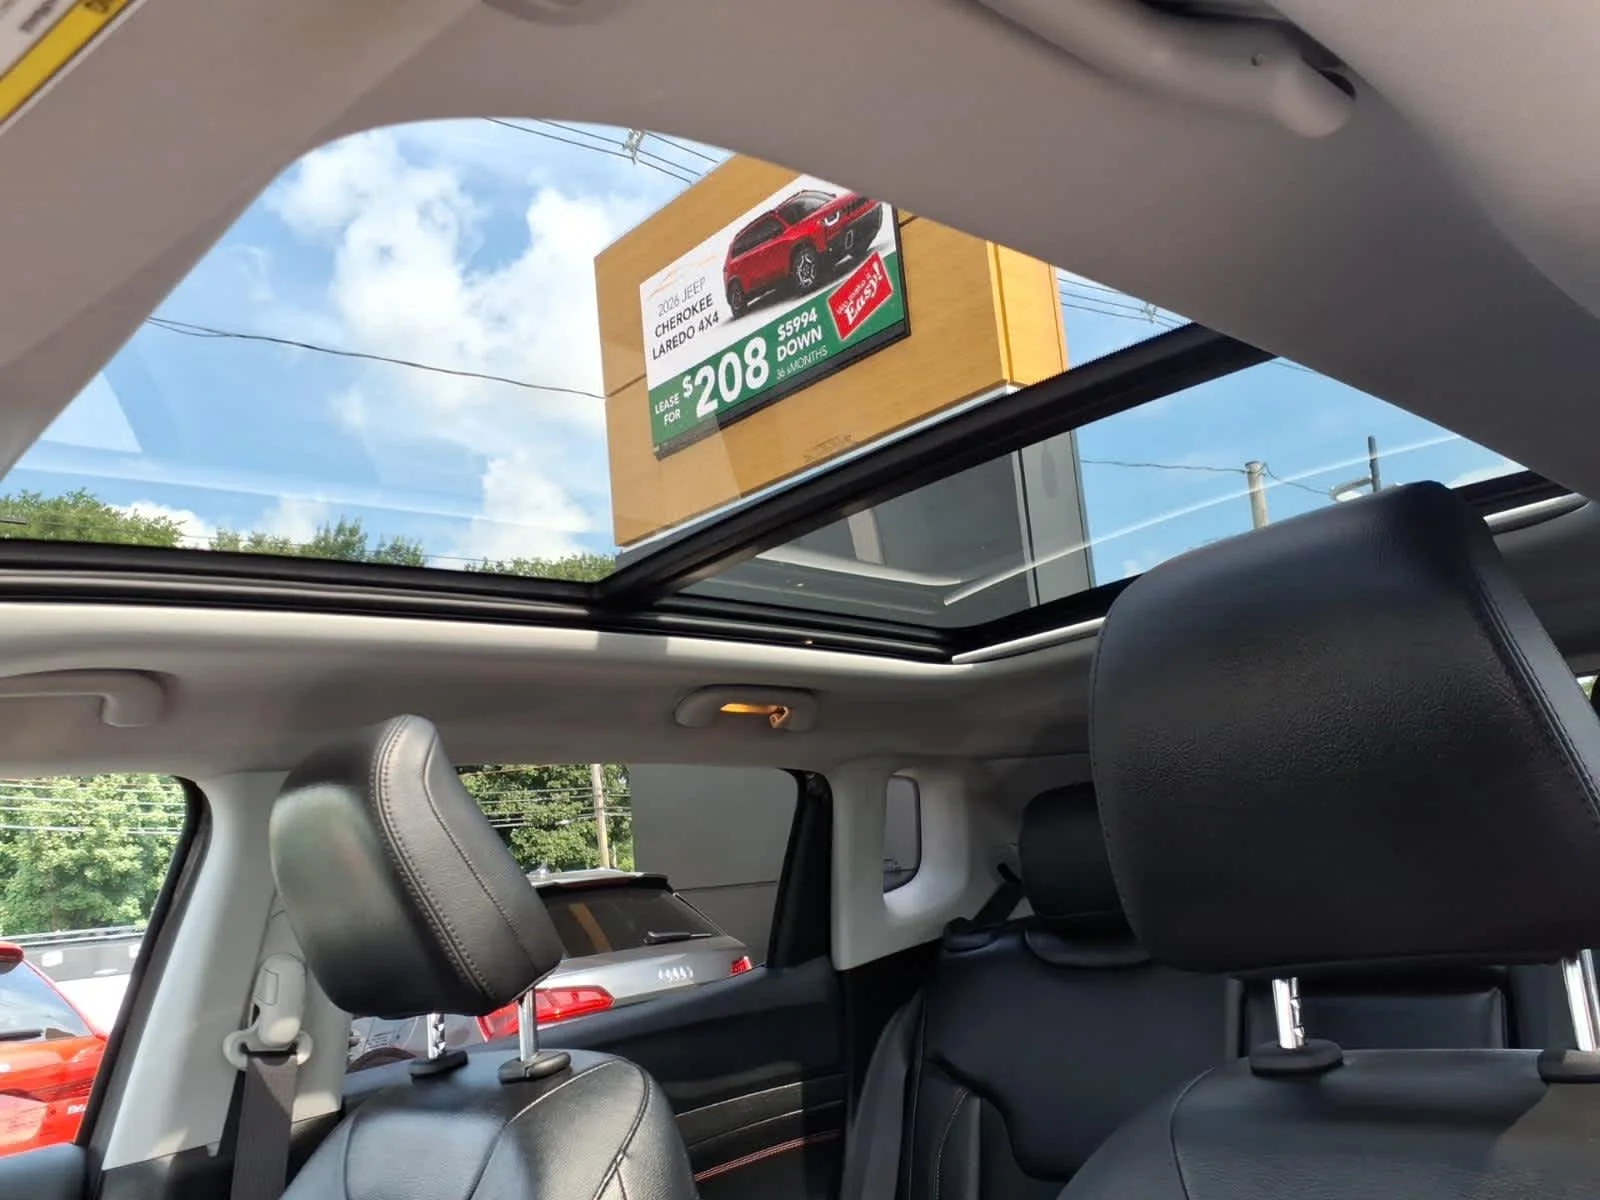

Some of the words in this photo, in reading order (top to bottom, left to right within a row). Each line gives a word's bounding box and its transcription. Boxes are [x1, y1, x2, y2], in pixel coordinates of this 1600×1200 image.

[682, 277, 706, 303] JEEP
[844, 261, 883, 325] Easy!
[655, 293, 713, 338] CHEROKEE
[777, 307, 818, 341] $5994
[652, 325, 695, 360] LAREDO
[698, 309, 719, 332] 4X4
[777, 324, 823, 362] DOWN
[655, 392, 680, 414] LEASE
[663, 409, 681, 427] FOR
